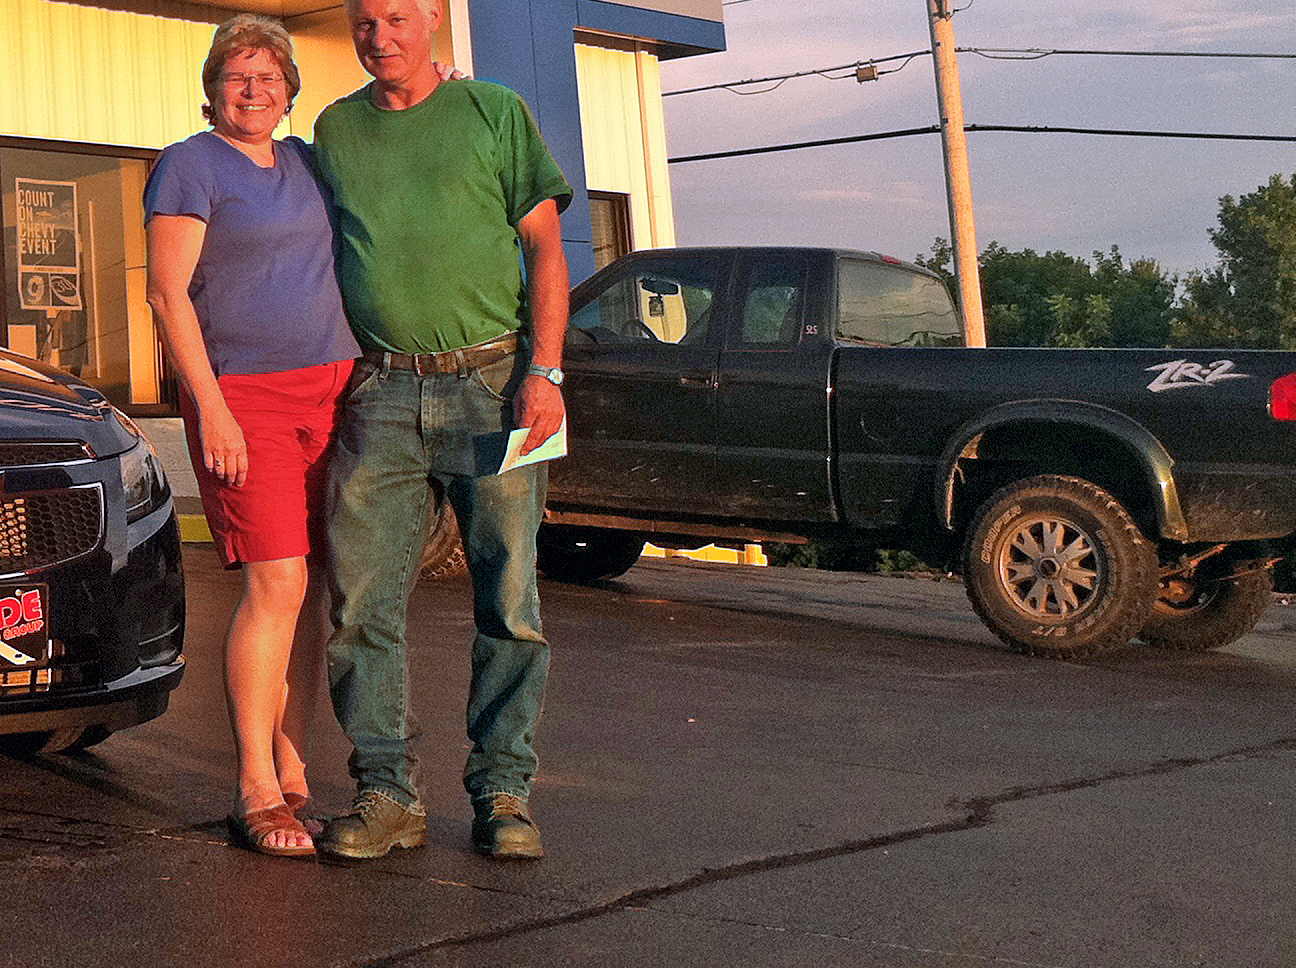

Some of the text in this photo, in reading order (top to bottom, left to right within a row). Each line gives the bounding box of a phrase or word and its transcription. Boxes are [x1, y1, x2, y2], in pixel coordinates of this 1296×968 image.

[17, 189, 54, 208] COUNT
[17, 206, 33, 222] ON
[19, 222, 56, 239] CHEVY
[20, 238, 57, 255] EVENT
[3, 620, 45, 640] GROUP
